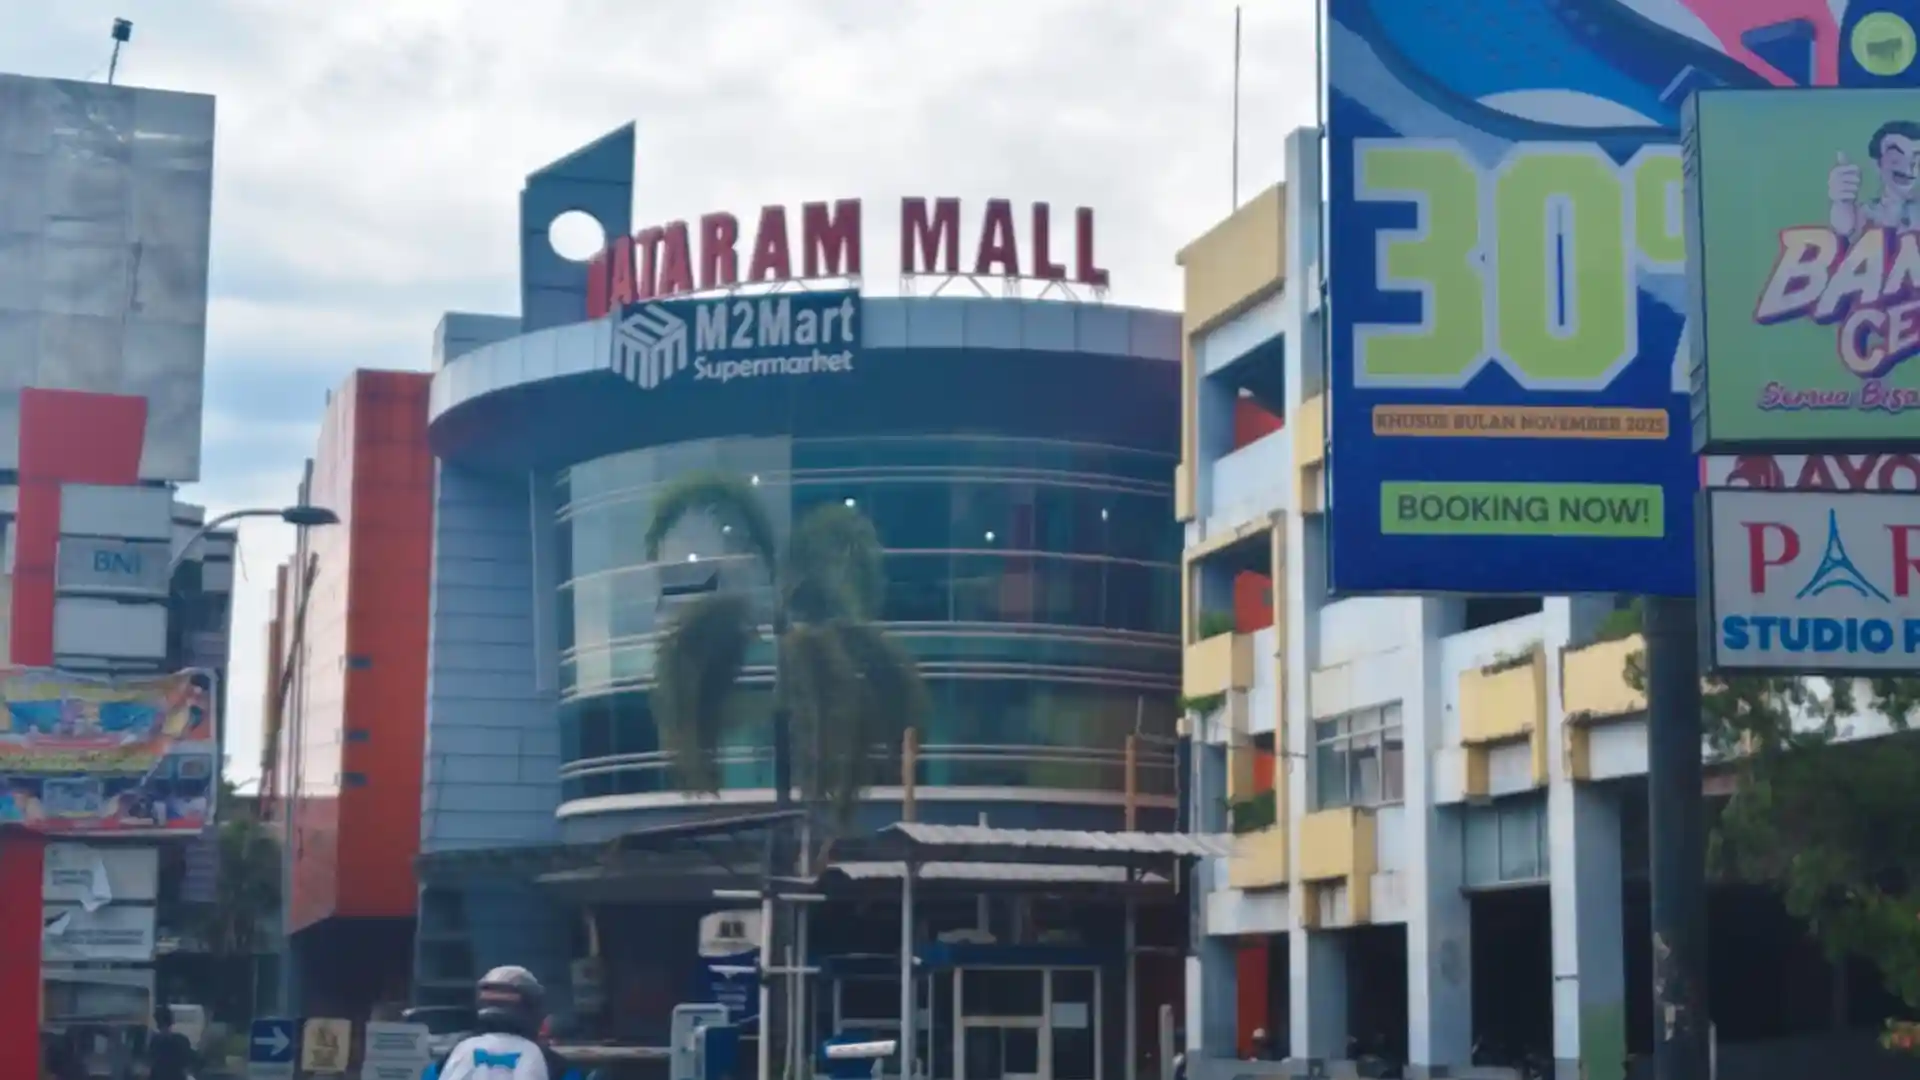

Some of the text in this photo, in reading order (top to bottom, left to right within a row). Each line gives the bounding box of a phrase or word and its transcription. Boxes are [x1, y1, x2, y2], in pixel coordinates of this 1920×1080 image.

[900, 196, 1110, 288] MALL
[695, 296, 855, 352] M2Mart
[693, 349, 855, 383] Supermarket
[1453, 413, 1516, 430] BULAN
[1521, 414, 1622, 432] NOVEMBER
[1397, 494, 1650, 524] BOOKING NOW!
[94, 549, 141, 576] BNI
[1722, 614, 1894, 653] STUDIO
